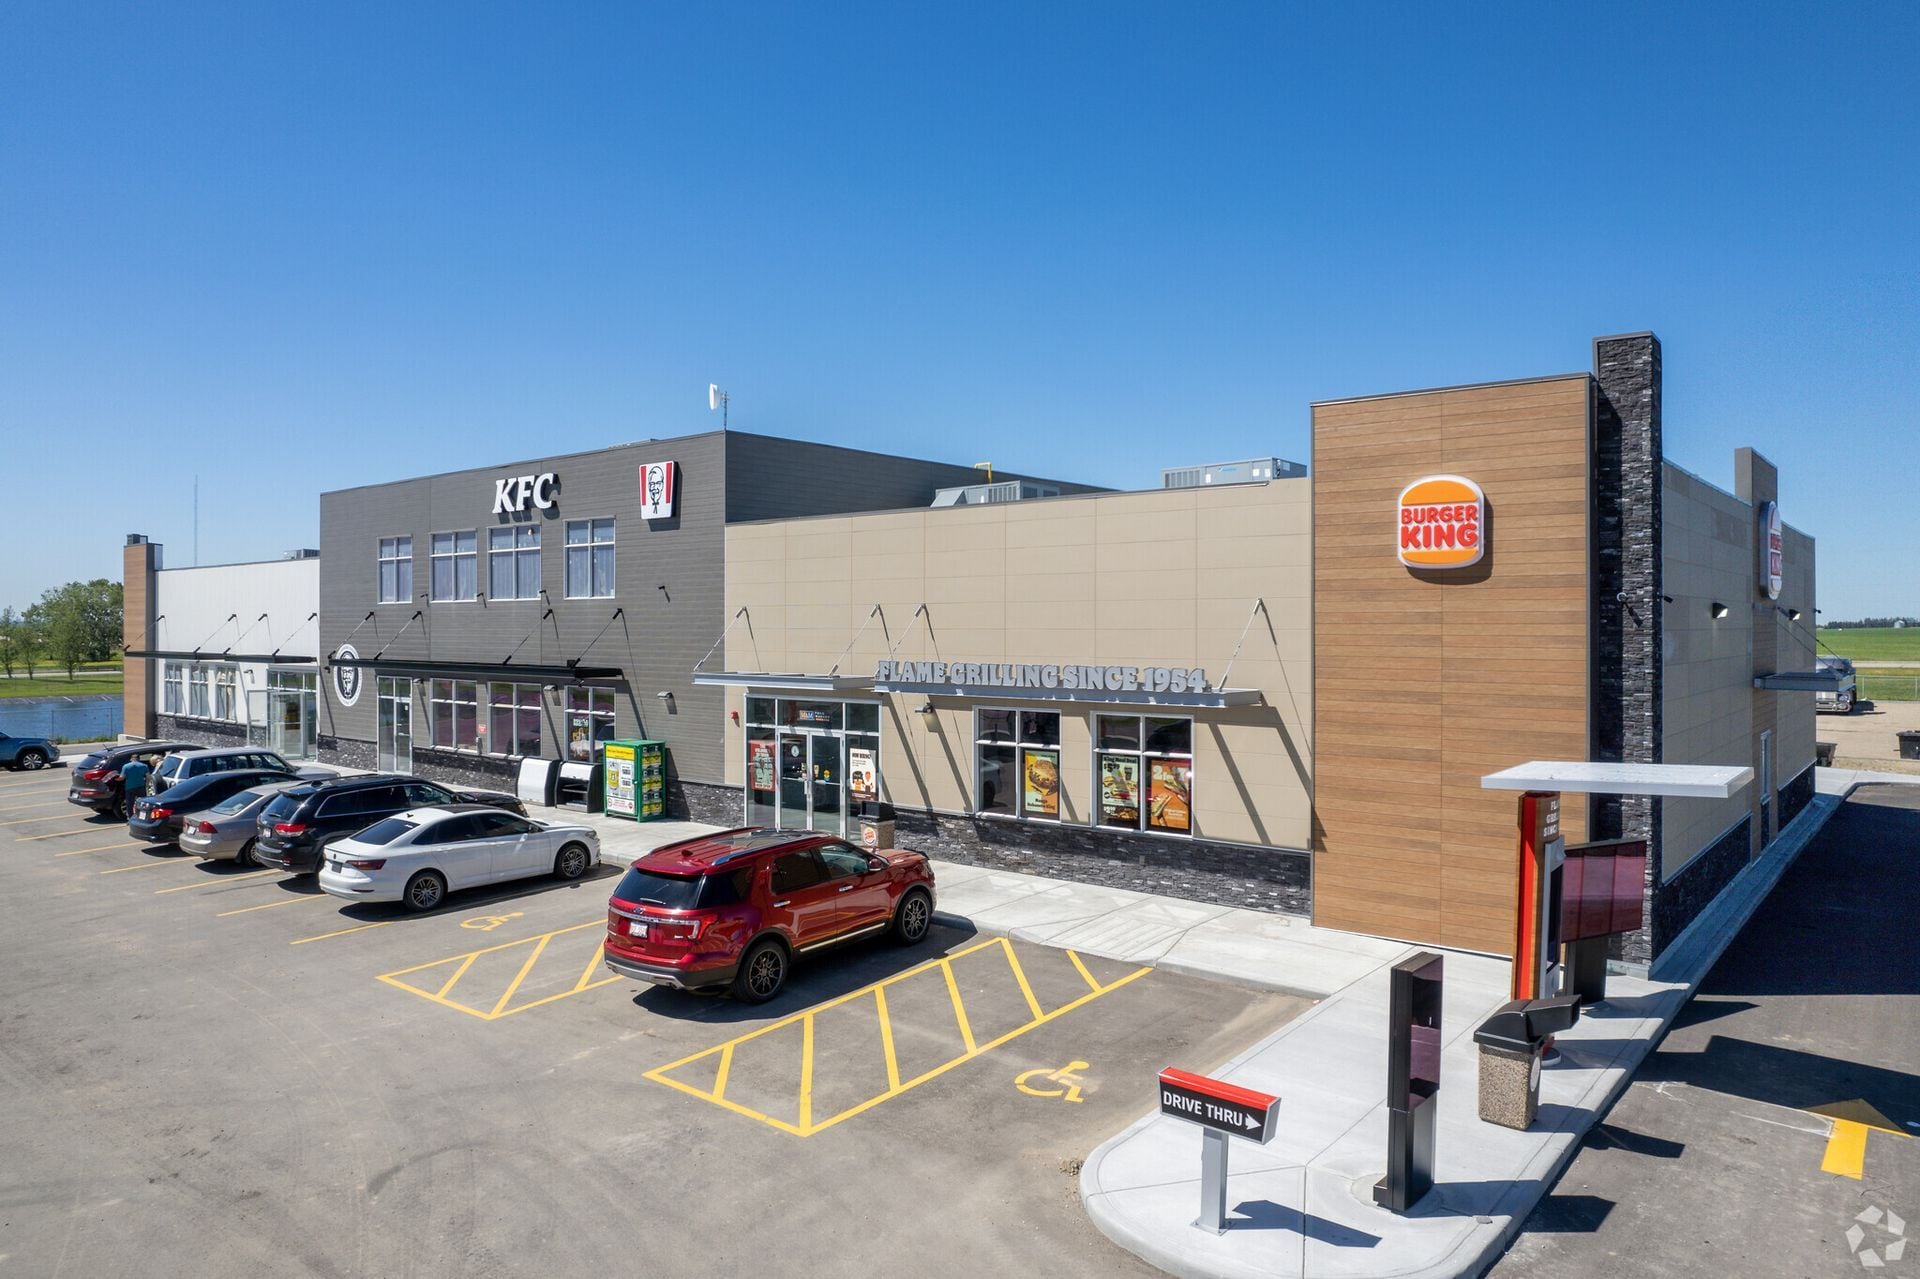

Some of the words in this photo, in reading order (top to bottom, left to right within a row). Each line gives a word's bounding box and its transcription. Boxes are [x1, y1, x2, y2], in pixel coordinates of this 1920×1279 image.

[492, 473, 554, 514] KFC
[1401, 504, 1478, 525] BURGER
[1401, 523, 1478, 549] KING
[878, 661, 947, 683] FLAME
[951, 663, 1060, 688] GRILLING
[1063, 664, 1139, 691] SINCE
[1142, 667, 1208, 693] 1954
[1153, 765, 1163, 780] 2
[1163, 1090, 1202, 1115] DRIVE
[1205, 1103, 1243, 1126] THRU
